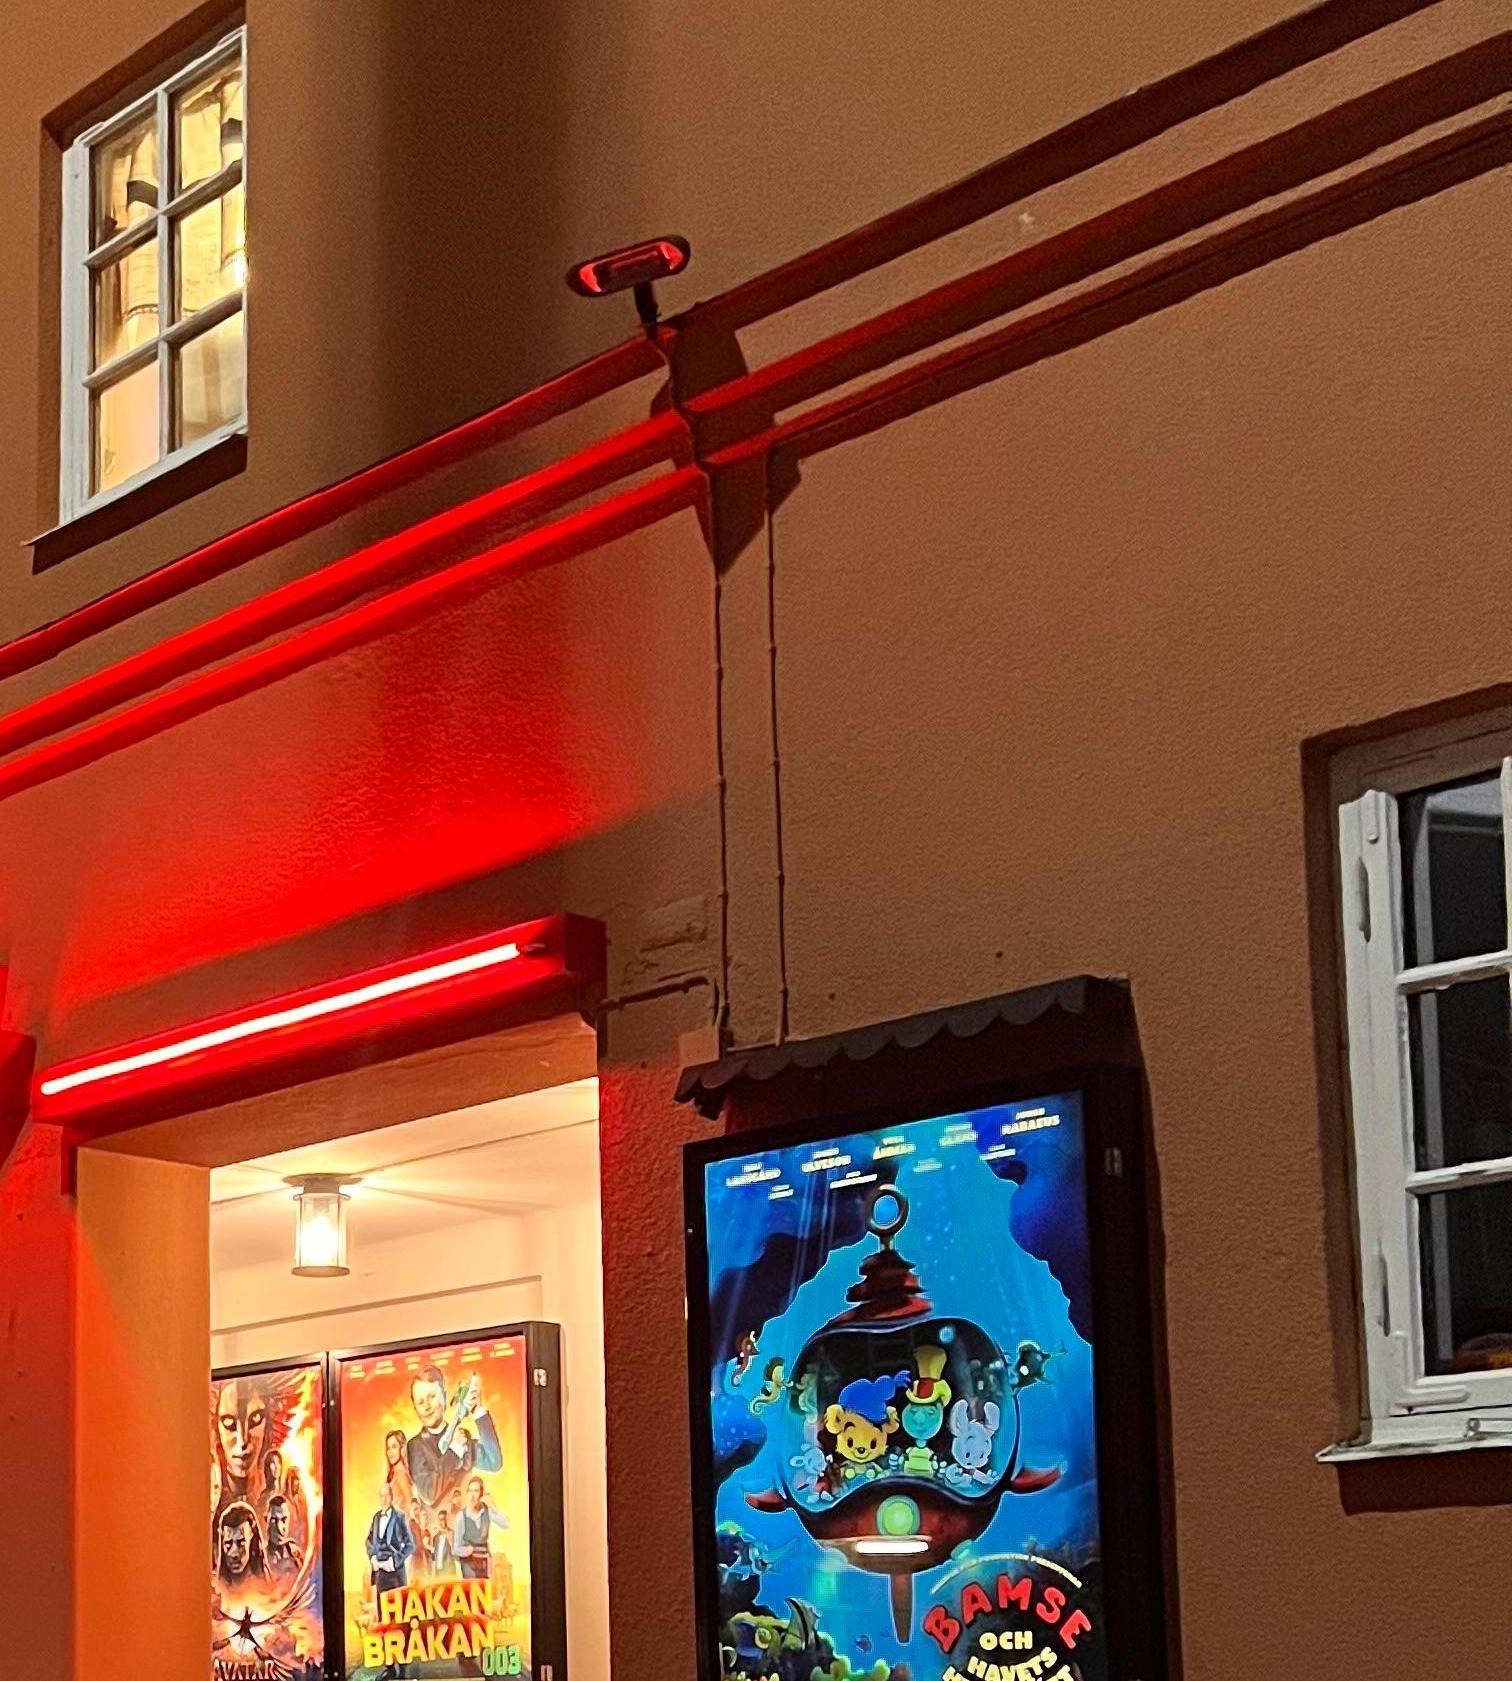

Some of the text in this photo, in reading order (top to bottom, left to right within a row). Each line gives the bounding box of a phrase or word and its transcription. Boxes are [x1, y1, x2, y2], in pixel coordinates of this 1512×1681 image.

[923, 1573, 1092, 1653] BAMSE
[363, 1618, 496, 1668] BRÅKAN
[978, 1630, 1034, 1651] OCH
[482, 1645, 522, 1676] 003
[967, 1646, 1058, 1681] HAVETS
